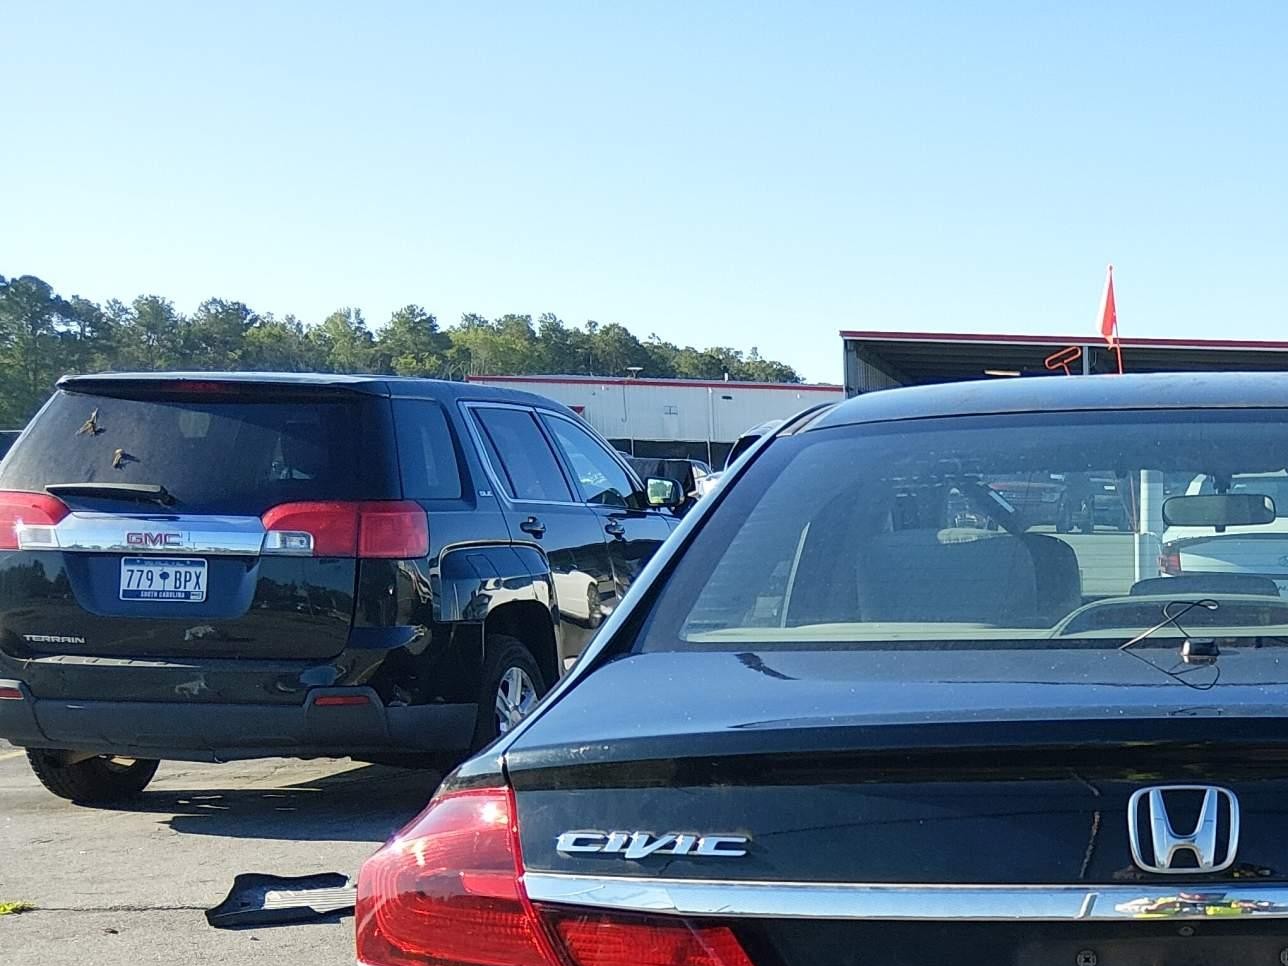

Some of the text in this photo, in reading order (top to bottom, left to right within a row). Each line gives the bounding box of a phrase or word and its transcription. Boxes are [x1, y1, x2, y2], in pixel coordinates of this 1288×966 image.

[127, 532, 182, 545] GMC
[126, 569, 202, 590] 779 BPX
[23, 634, 85, 643] TERRAIN
[556, 831, 748, 858] CIVIC
